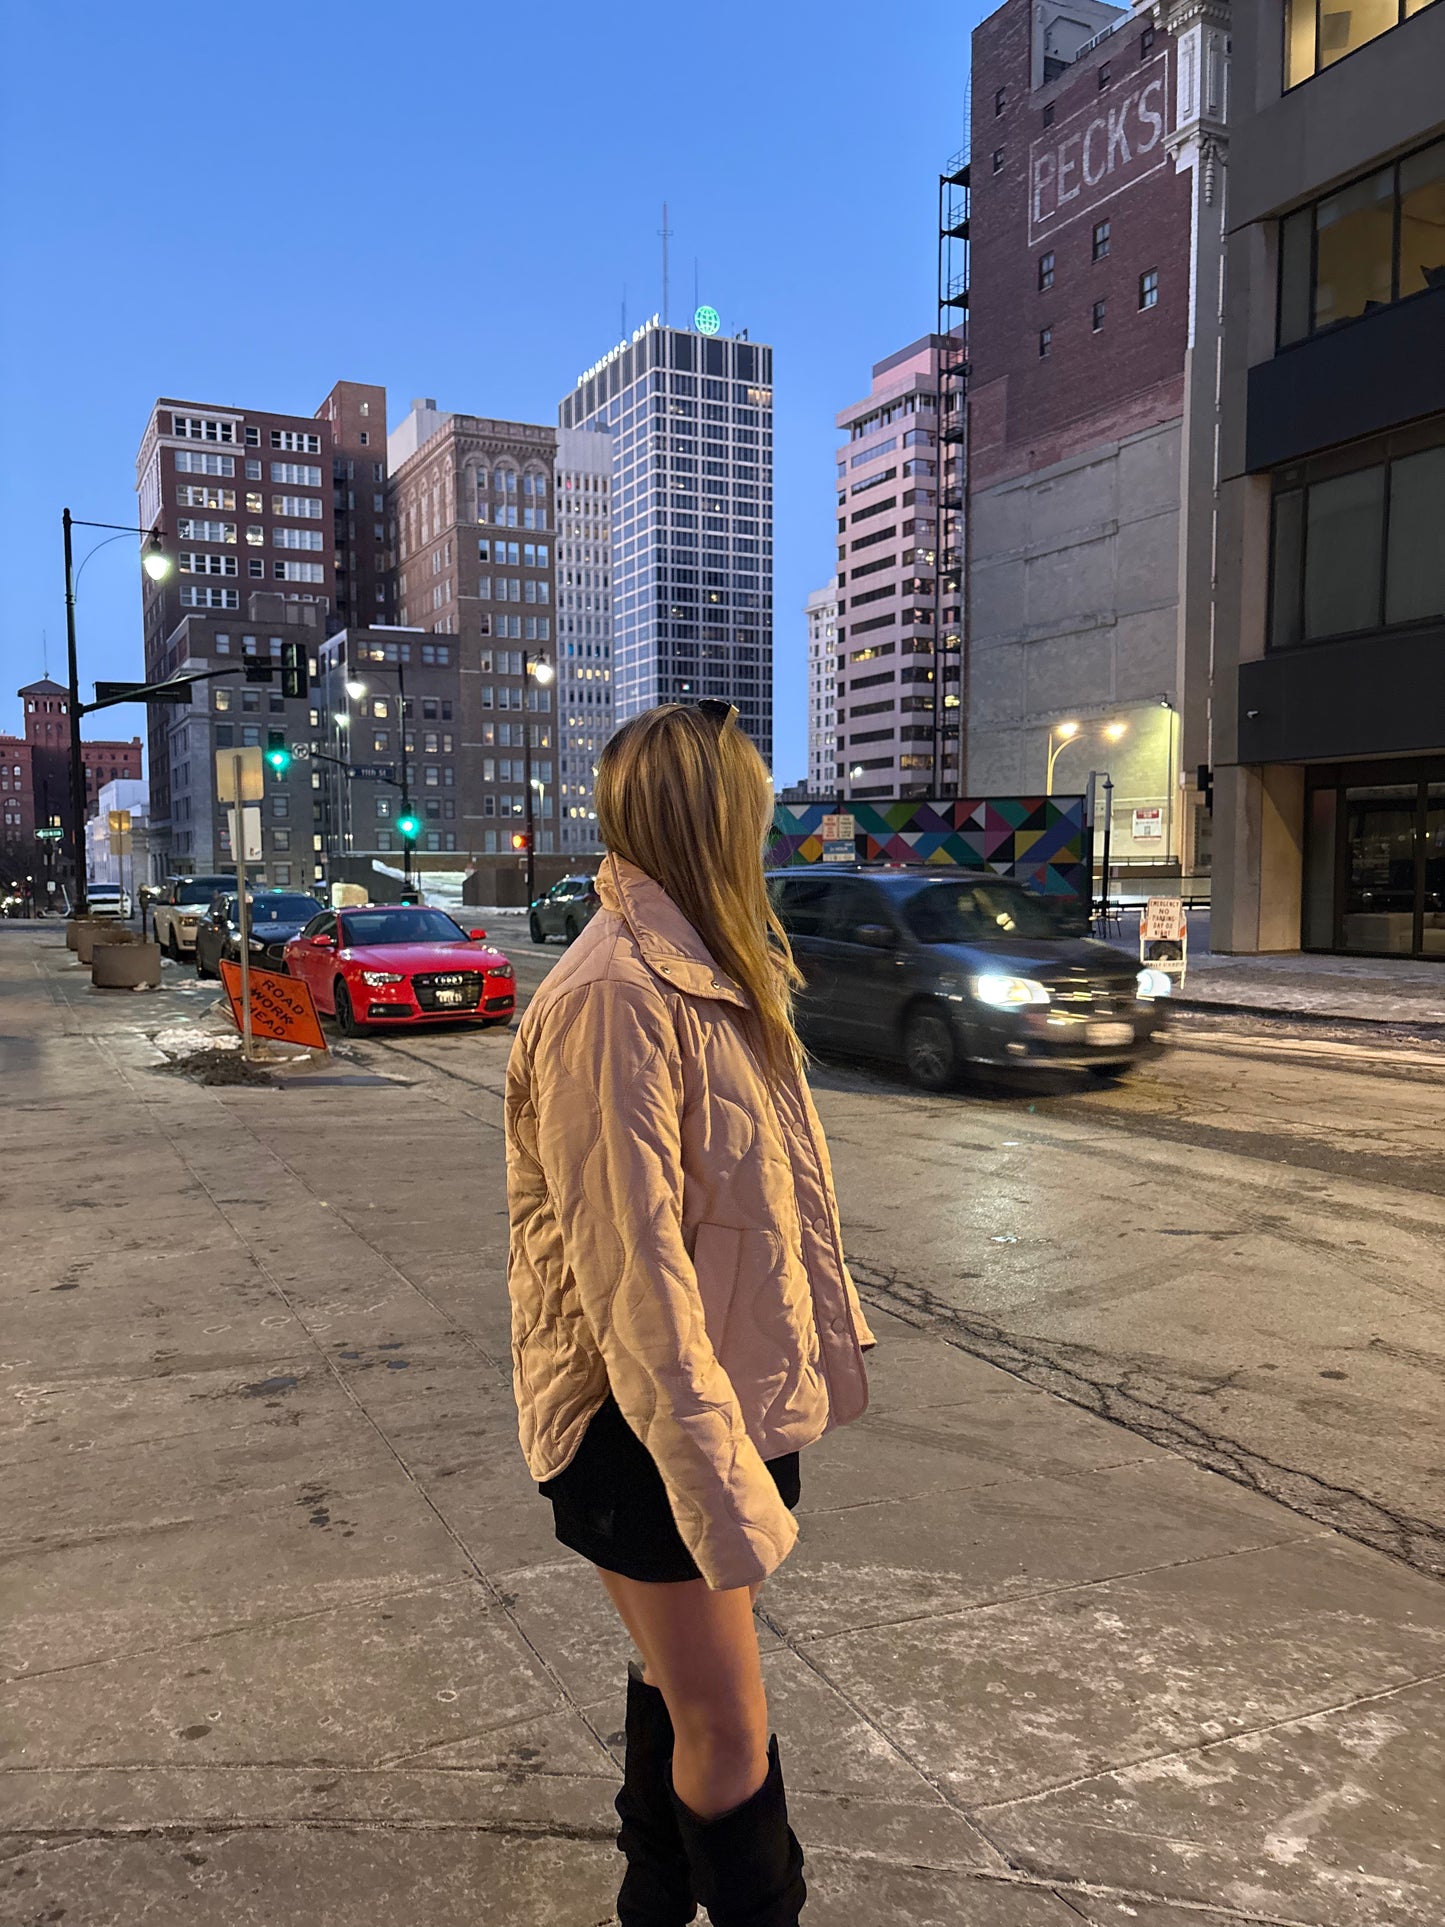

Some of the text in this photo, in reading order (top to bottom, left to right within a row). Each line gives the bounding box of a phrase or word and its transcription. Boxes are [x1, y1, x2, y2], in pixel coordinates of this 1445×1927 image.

[1150, 900, 1180, 908] EMERGENCY
[1152, 914, 1175, 922] PARKING
[251, 988, 294, 1025] WORK
[262, 979, 304, 1015] ROAD
